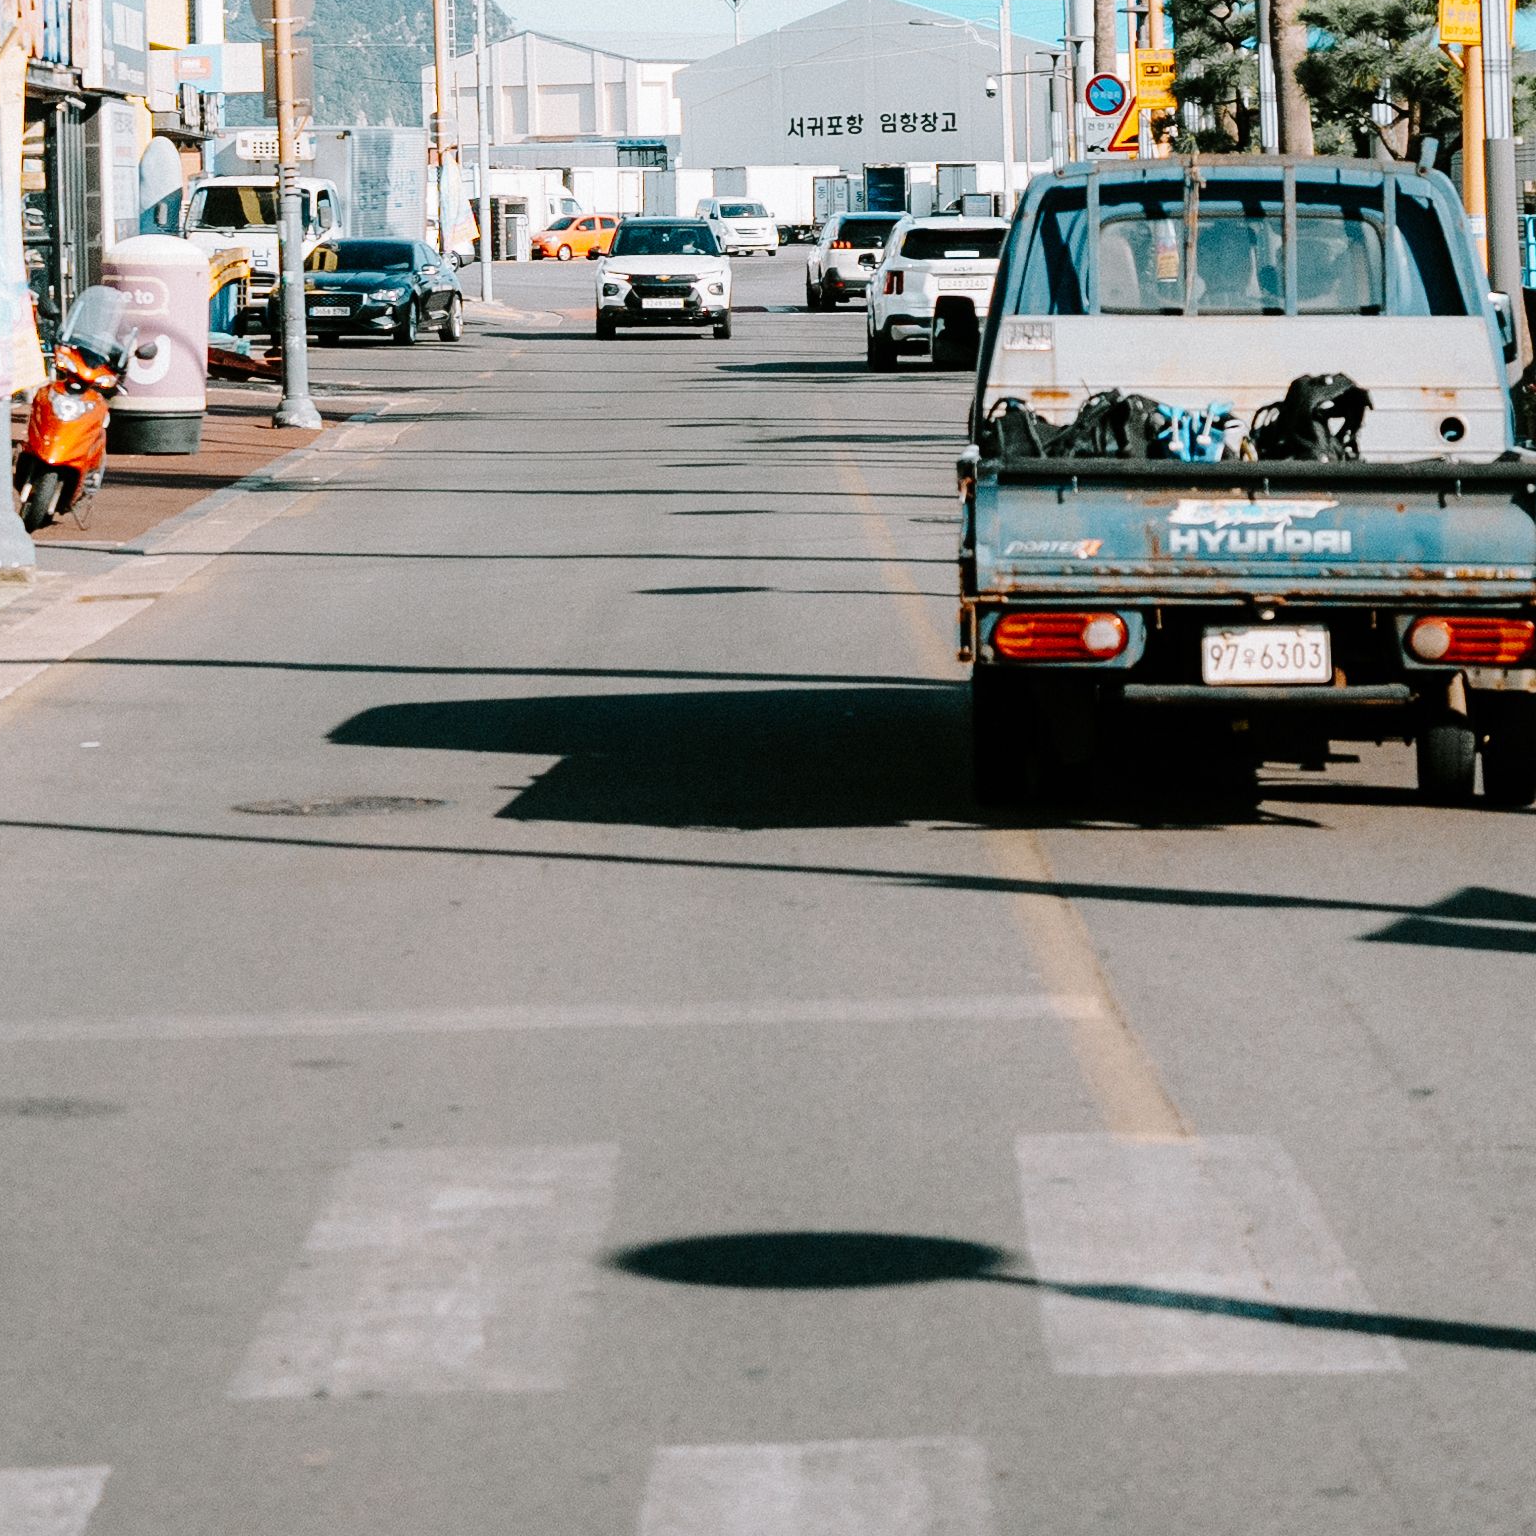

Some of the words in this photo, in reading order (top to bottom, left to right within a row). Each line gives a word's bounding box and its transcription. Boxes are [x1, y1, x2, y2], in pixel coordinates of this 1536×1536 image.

[787, 114, 864, 138] 서귀포항
[880, 112, 958, 134] 임항창고
[1088, 121, 1117, 131] 견인지
[135, 289, 155, 305] to
[1169, 529, 1352, 554] HYUNDAI
